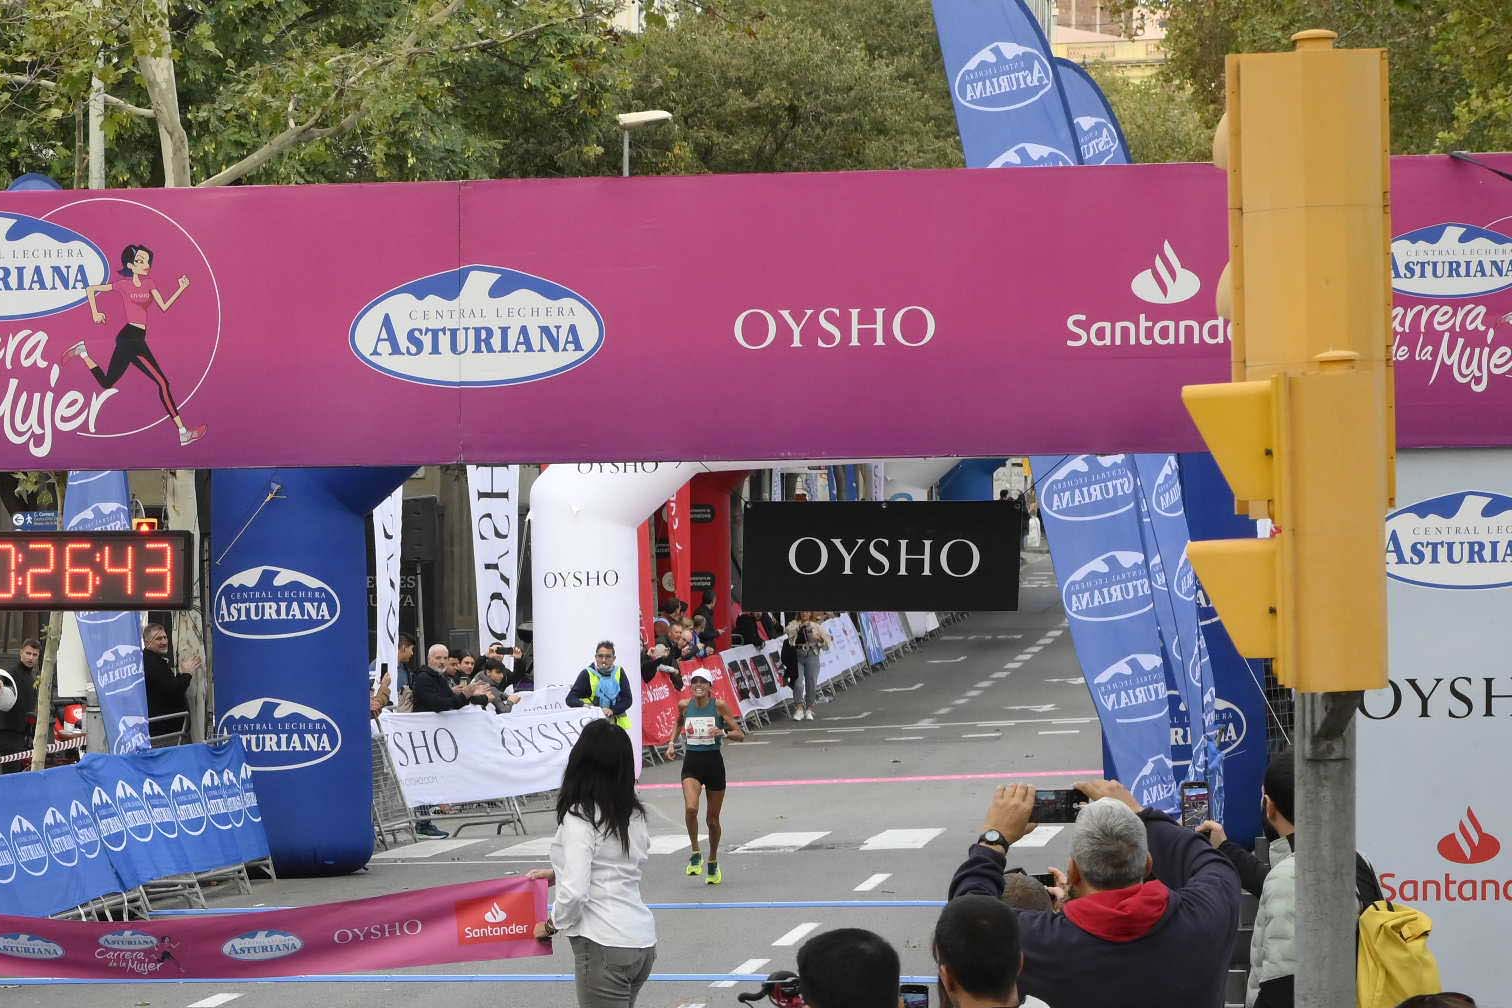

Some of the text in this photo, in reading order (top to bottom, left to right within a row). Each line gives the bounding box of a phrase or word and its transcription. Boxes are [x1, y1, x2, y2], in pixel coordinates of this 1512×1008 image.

[12, 248, 86, 260] LECHERA
[409, 306, 577, 321] CENTRAL LECHERA
[1392, 303, 1487, 333] arrera
[369, 312, 585, 357] ASTURIANA
[733, 305, 936, 350] OYSHO
[1066, 312, 1232, 348] Santand
[1415, 333, 1433, 361] la
[1428, 327, 1512, 393] Muje
[1412, 526, 1480, 536] CENTRAL
[788, 536, 981, 578] OYSHO
[544, 569, 619, 589] OYSHO
[230, 590, 326, 600] CENTRAL LECHERA
[218, 596, 331, 623] ASTURIANA
[232, 722, 327, 731] CENTRAL LECHERA
[224, 726, 332, 752] TURIANA
[1380, 872, 1512, 902] Santan
[333, 919, 423, 944] OYSHO
[464, 922, 528, 939] Santander
[94, 948, 145, 960] Carrera
[229, 943, 297, 955] ASTURIANA
[126, 958, 164, 976] Mujer
